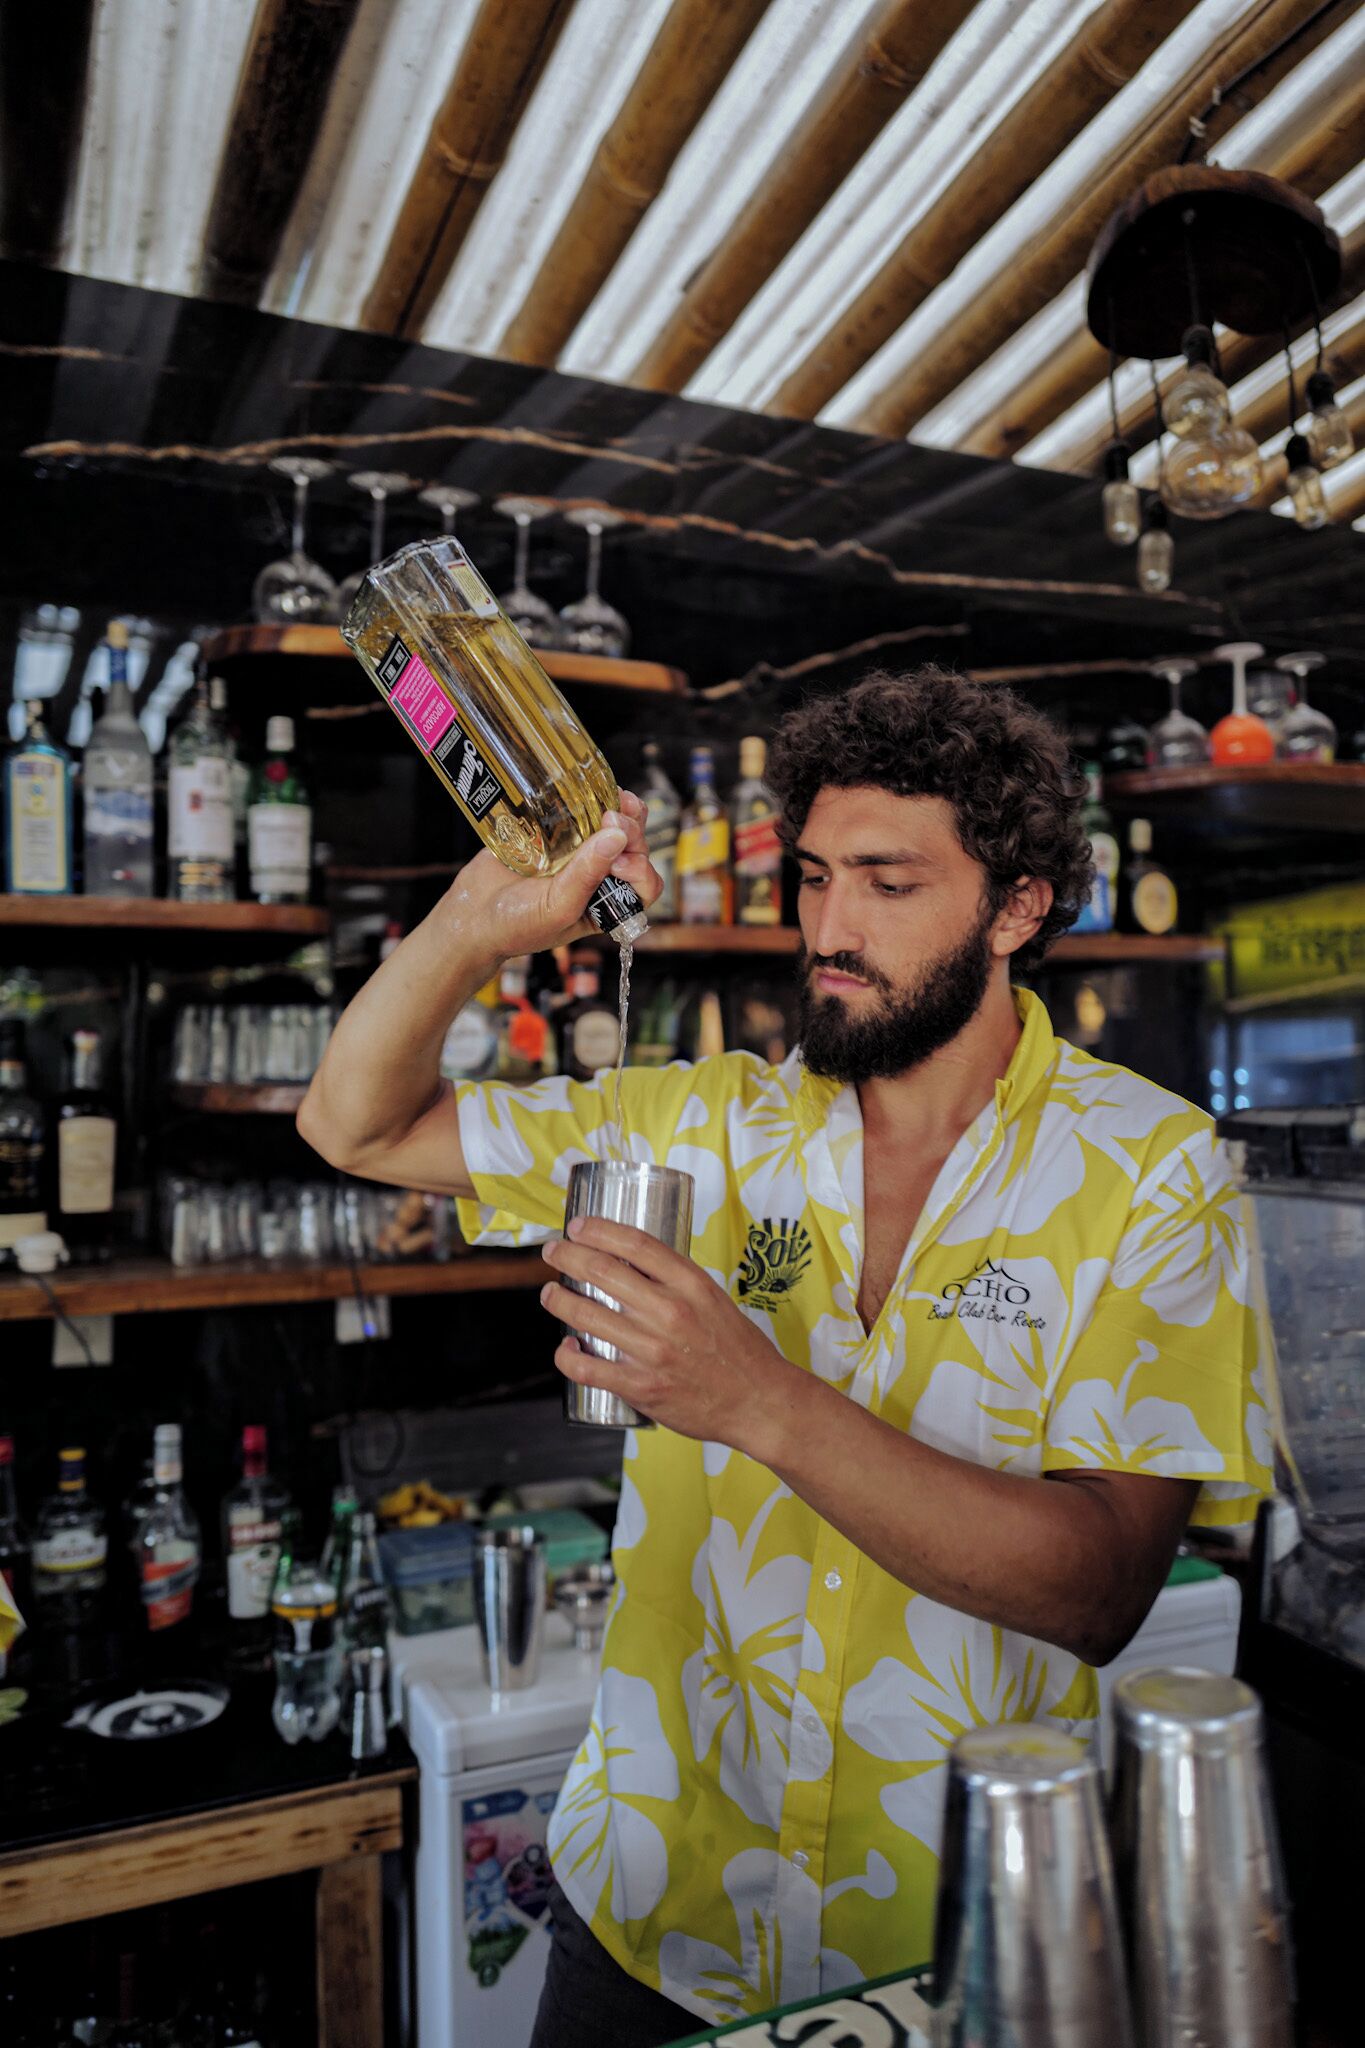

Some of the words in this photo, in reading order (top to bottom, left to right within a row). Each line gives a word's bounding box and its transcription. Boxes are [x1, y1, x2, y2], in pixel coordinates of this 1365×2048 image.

[422, 699, 447, 734] REPOSADO
[472, 782, 496, 808] TEQUILA
[942, 1279, 1030, 1304] OCHO
[958, 1301, 986, 1318] Club
